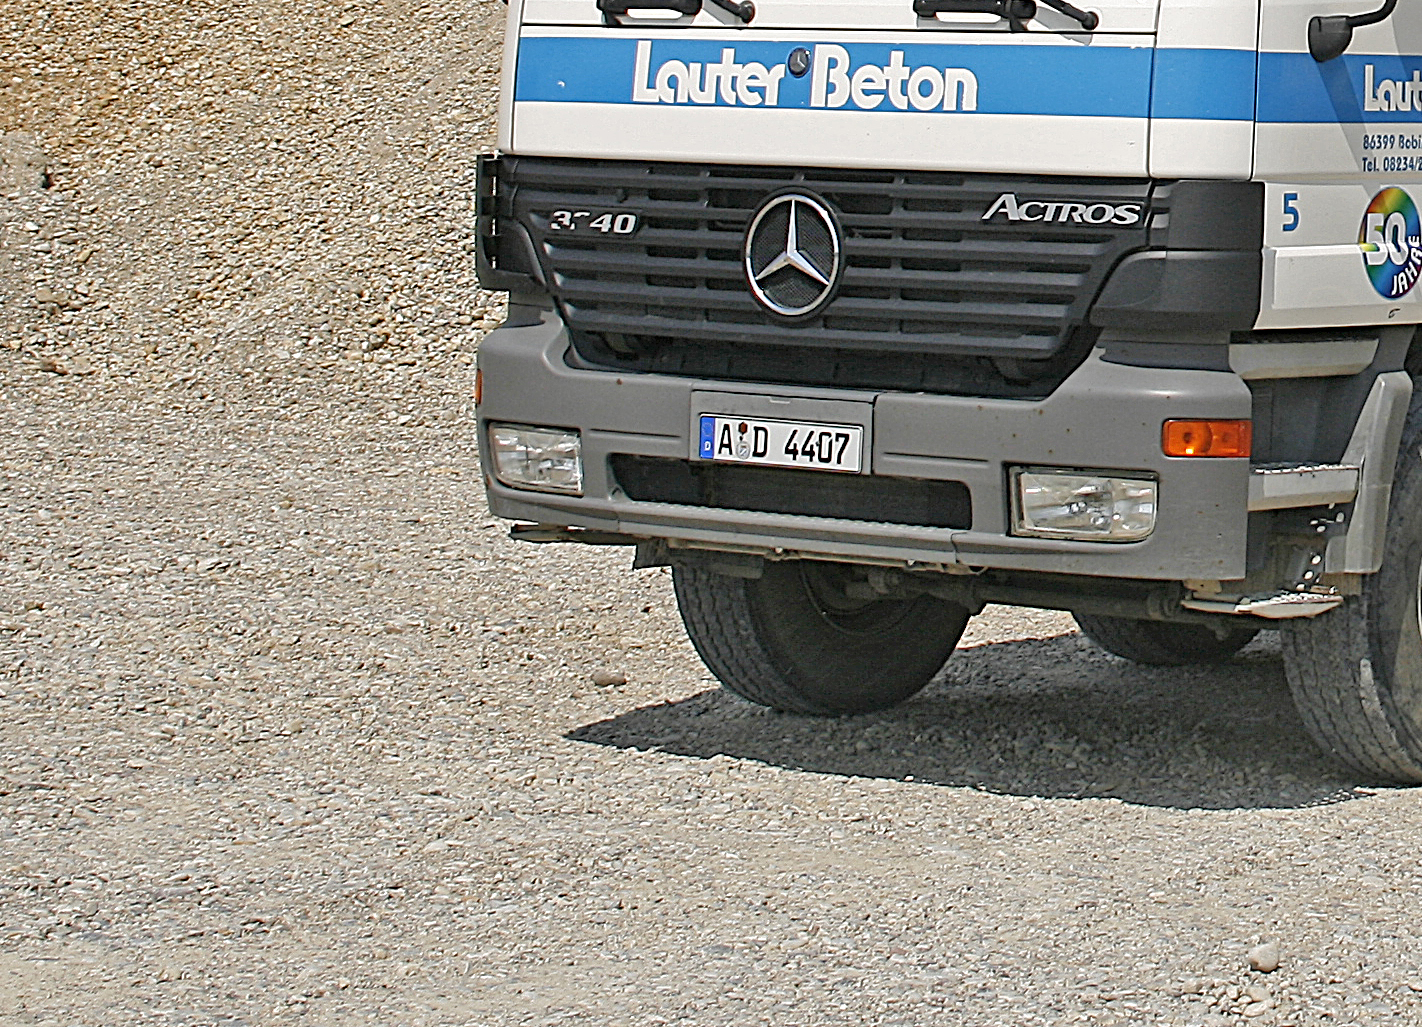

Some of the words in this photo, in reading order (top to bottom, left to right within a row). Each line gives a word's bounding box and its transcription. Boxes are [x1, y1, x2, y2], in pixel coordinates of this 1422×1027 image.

[632, 39, 786, 106] Lauter
[810, 43, 979, 111] Beton
[1363, 134, 1395, 150] 86399
[1362, 157, 1380, 172] Tel.
[1282, 192, 1300, 232] 5
[1363, 212, 1409, 266] 50
[1391, 235, 1422, 296] JAHRE
[784, 429, 850, 464] 4407
